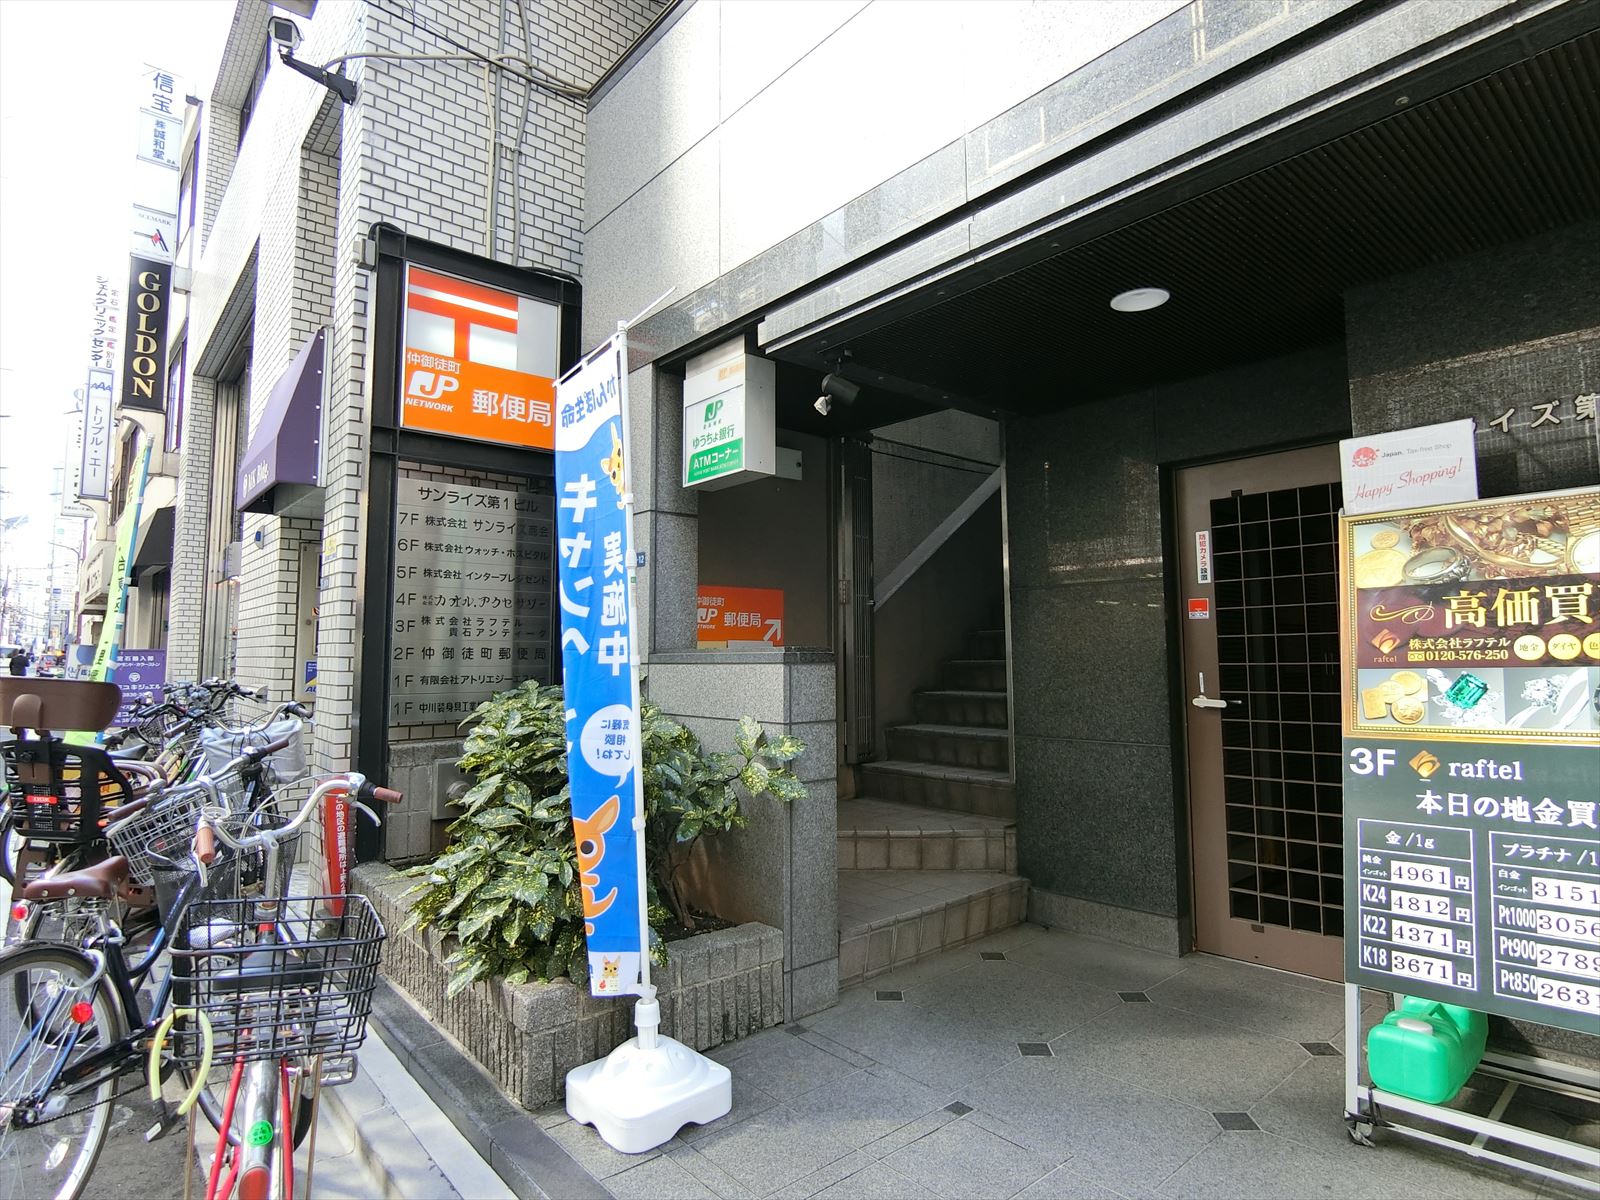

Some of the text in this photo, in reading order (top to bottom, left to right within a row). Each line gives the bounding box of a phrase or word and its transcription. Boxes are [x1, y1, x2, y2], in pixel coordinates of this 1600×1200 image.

[131, 271, 161, 398] GOLDON
[407, 352, 461, 375] 仲御徒町
[408, 370, 459, 399] JP
[405, 397, 454, 413] NETWORK
[472, 389, 552, 427] 郵便局
[704, 399, 724, 422] JP
[692, 424, 735, 450] ゆうちょ銀行
[693, 447, 739, 470] ATMコーナー
[1355, 457, 1463, 501] Happy Shopping!
[418, 486, 538, 513] サンライズ第1ビル
[399, 512, 419, 525] 7F
[425, 515, 468, 529] 株式会社
[398, 539, 419, 552] 6F
[424, 542, 463, 554] 株式会社
[397, 566, 417, 579] 5F
[423, 568, 461, 580] 株式会社
[396, 593, 416, 605] 4F
[1441, 582, 1600, 629] 高価買
[395, 619, 416, 633] 3F
[724, 611, 761, 628] 郵便局
[394, 647, 415, 660] 2F
[1408, 634, 1511, 650] 株式会社ラフテル
[1552, 642, 1577, 651] ダイヤ
[1373, 655, 1397, 663] raftel
[1426, 649, 1508, 662] 0120-576-250
[394, 675, 414, 688] 1F
[394, 701, 481, 715] 1F 中川装身具工業
[1349, 747, 1523, 781] 3F raftel
[1415, 789, 1600, 829] 本日の地金買
[1385, 830, 1402, 845] 金
[1502, 842, 1572, 862] プラチナ
[1393, 865, 1448, 885] 4961
[1455, 875, 1470, 890] 円
[1498, 868, 1521, 880] 白金
[1362, 883, 1471, 922] K24 4812 円
[1498, 881, 1600, 905] インゴット 3151
[1498, 904, 1537, 929] Pt1000
[1363, 914, 1471, 955] K22 4371 円
[1499, 936, 1537, 961] Pt900
[1363, 945, 1472, 987] K18 3671 円
[1500, 969, 1538, 995] Pt850
